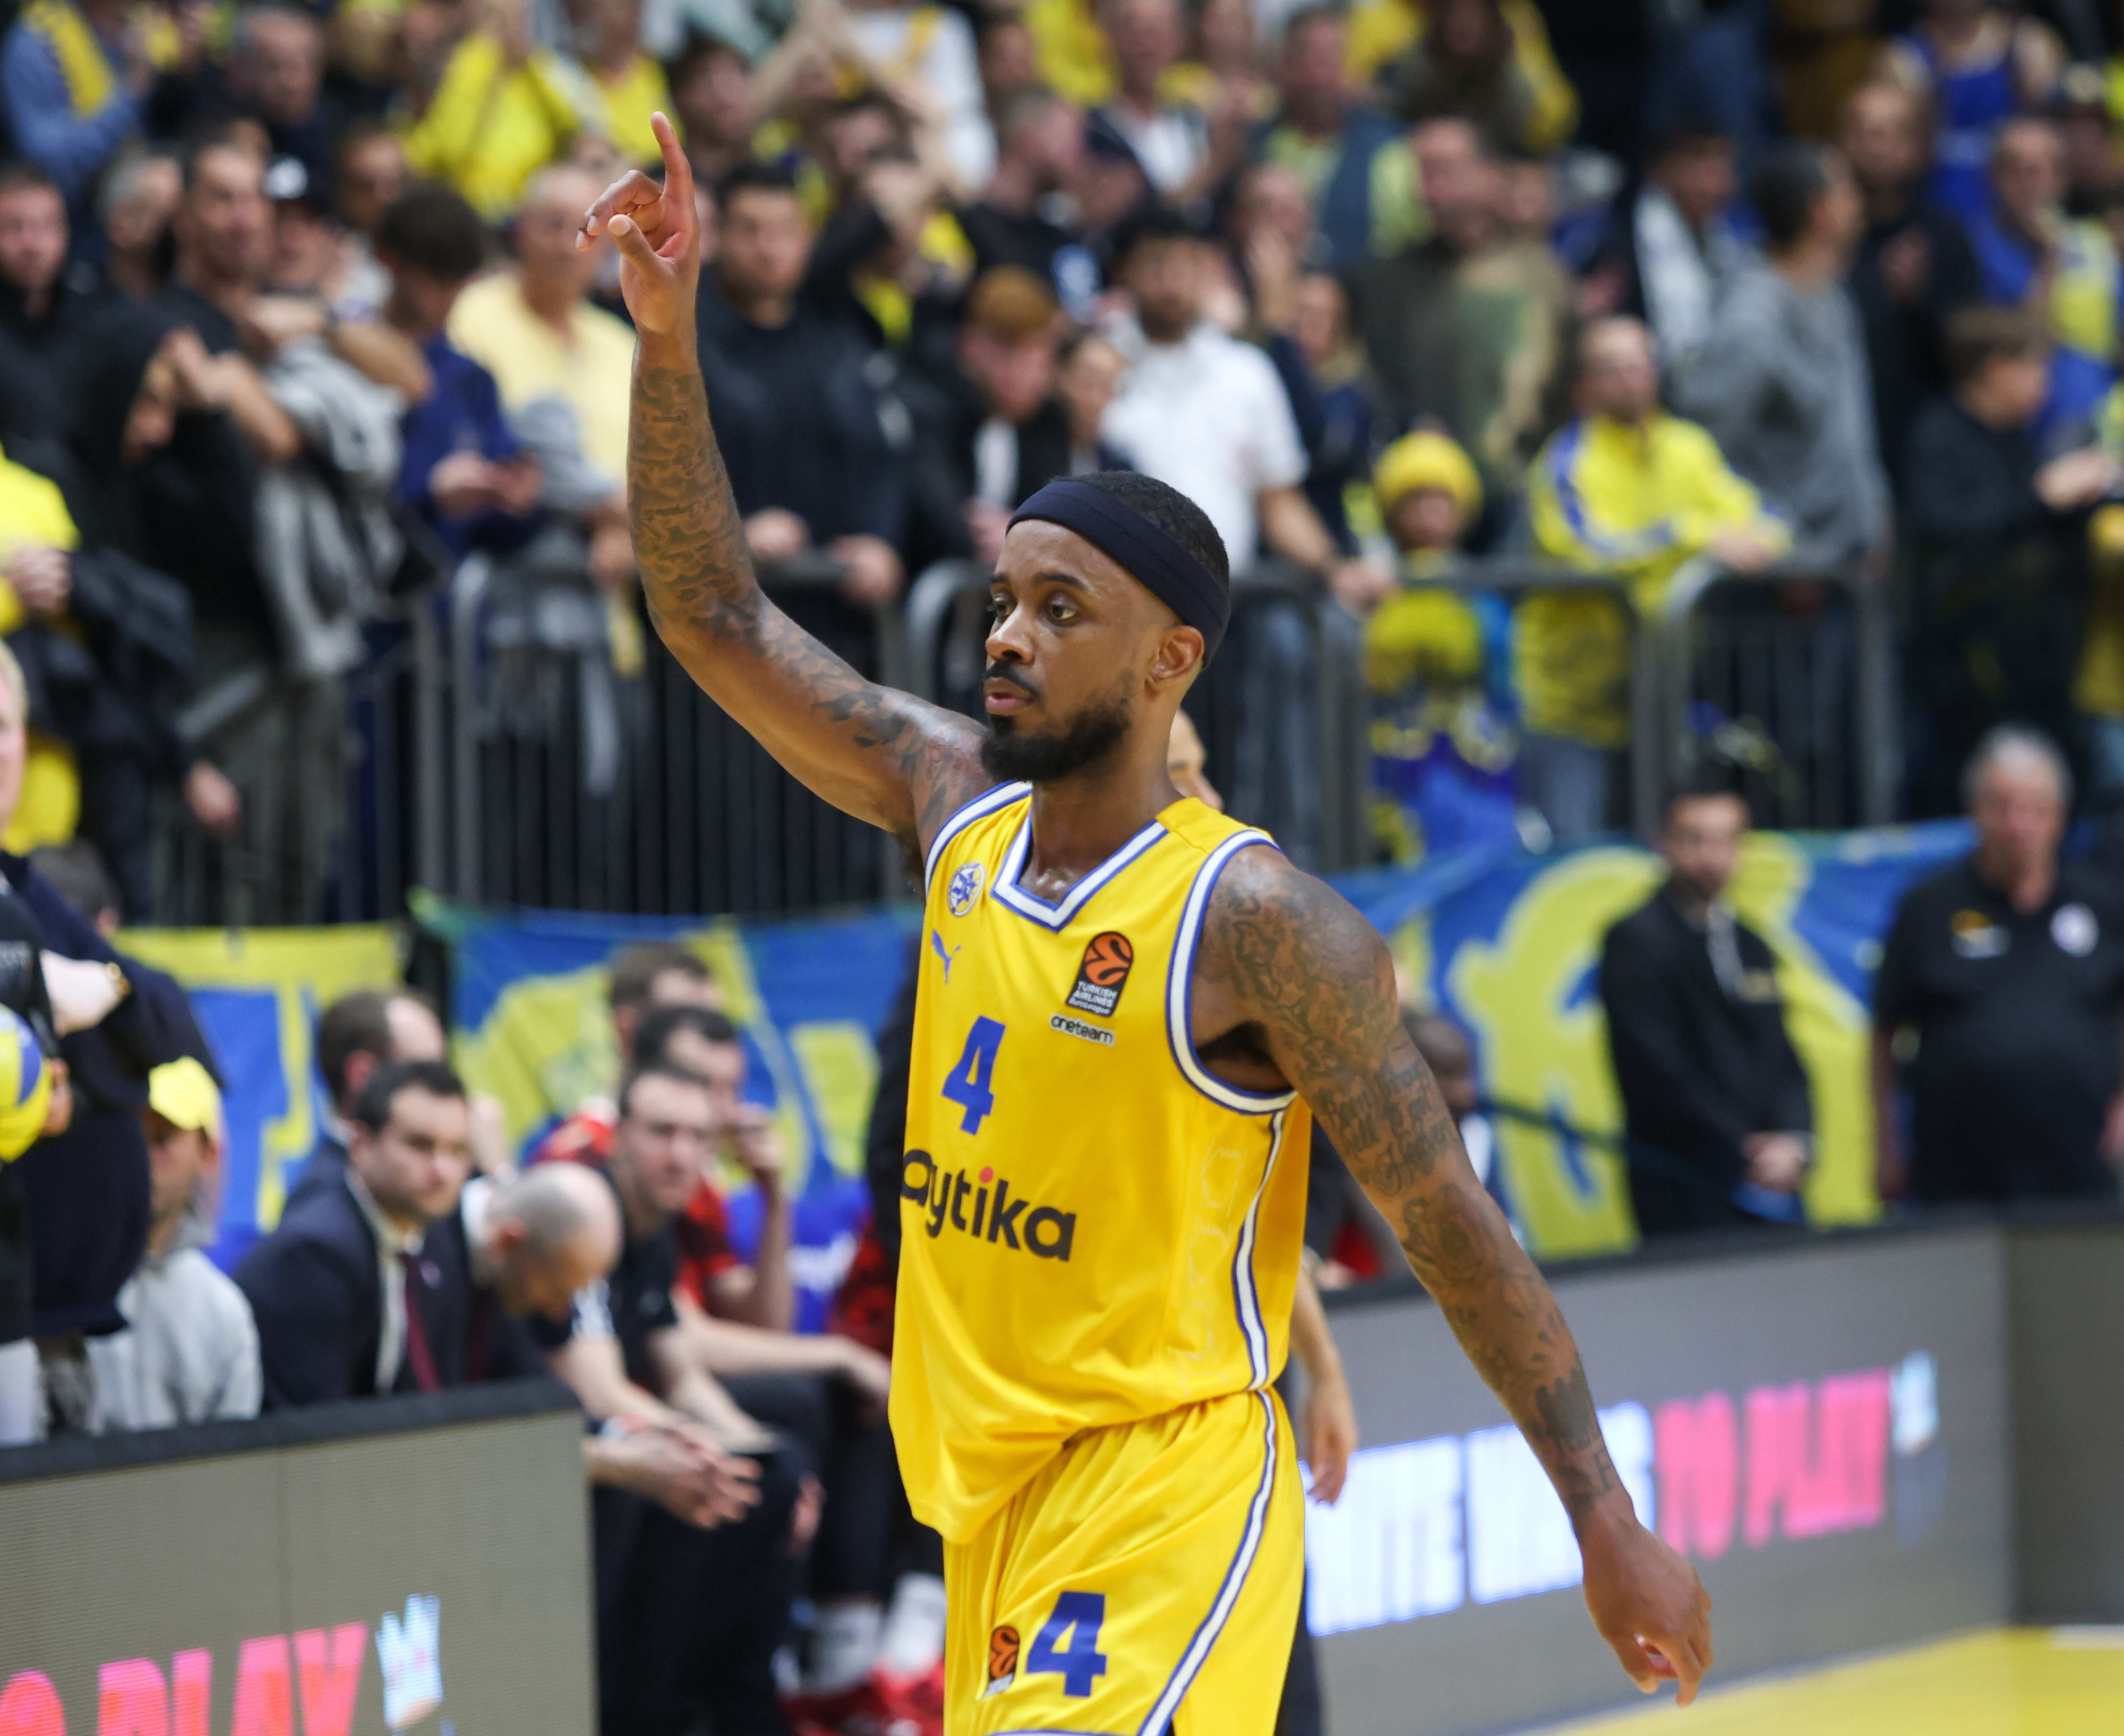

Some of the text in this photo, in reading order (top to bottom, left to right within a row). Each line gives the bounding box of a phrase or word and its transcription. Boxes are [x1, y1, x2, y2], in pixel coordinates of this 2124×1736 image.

[1073, 990, 1114, 1008] AIRLINES
[1078, 980, 1117, 999] TURKISH
[1051, 1016, 1112, 1044] oneteam
[941, 1015, 1005, 1135] 4
[901, 1149, 1076, 1262] aytika
[1026, 1591, 1107, 1697] 4
